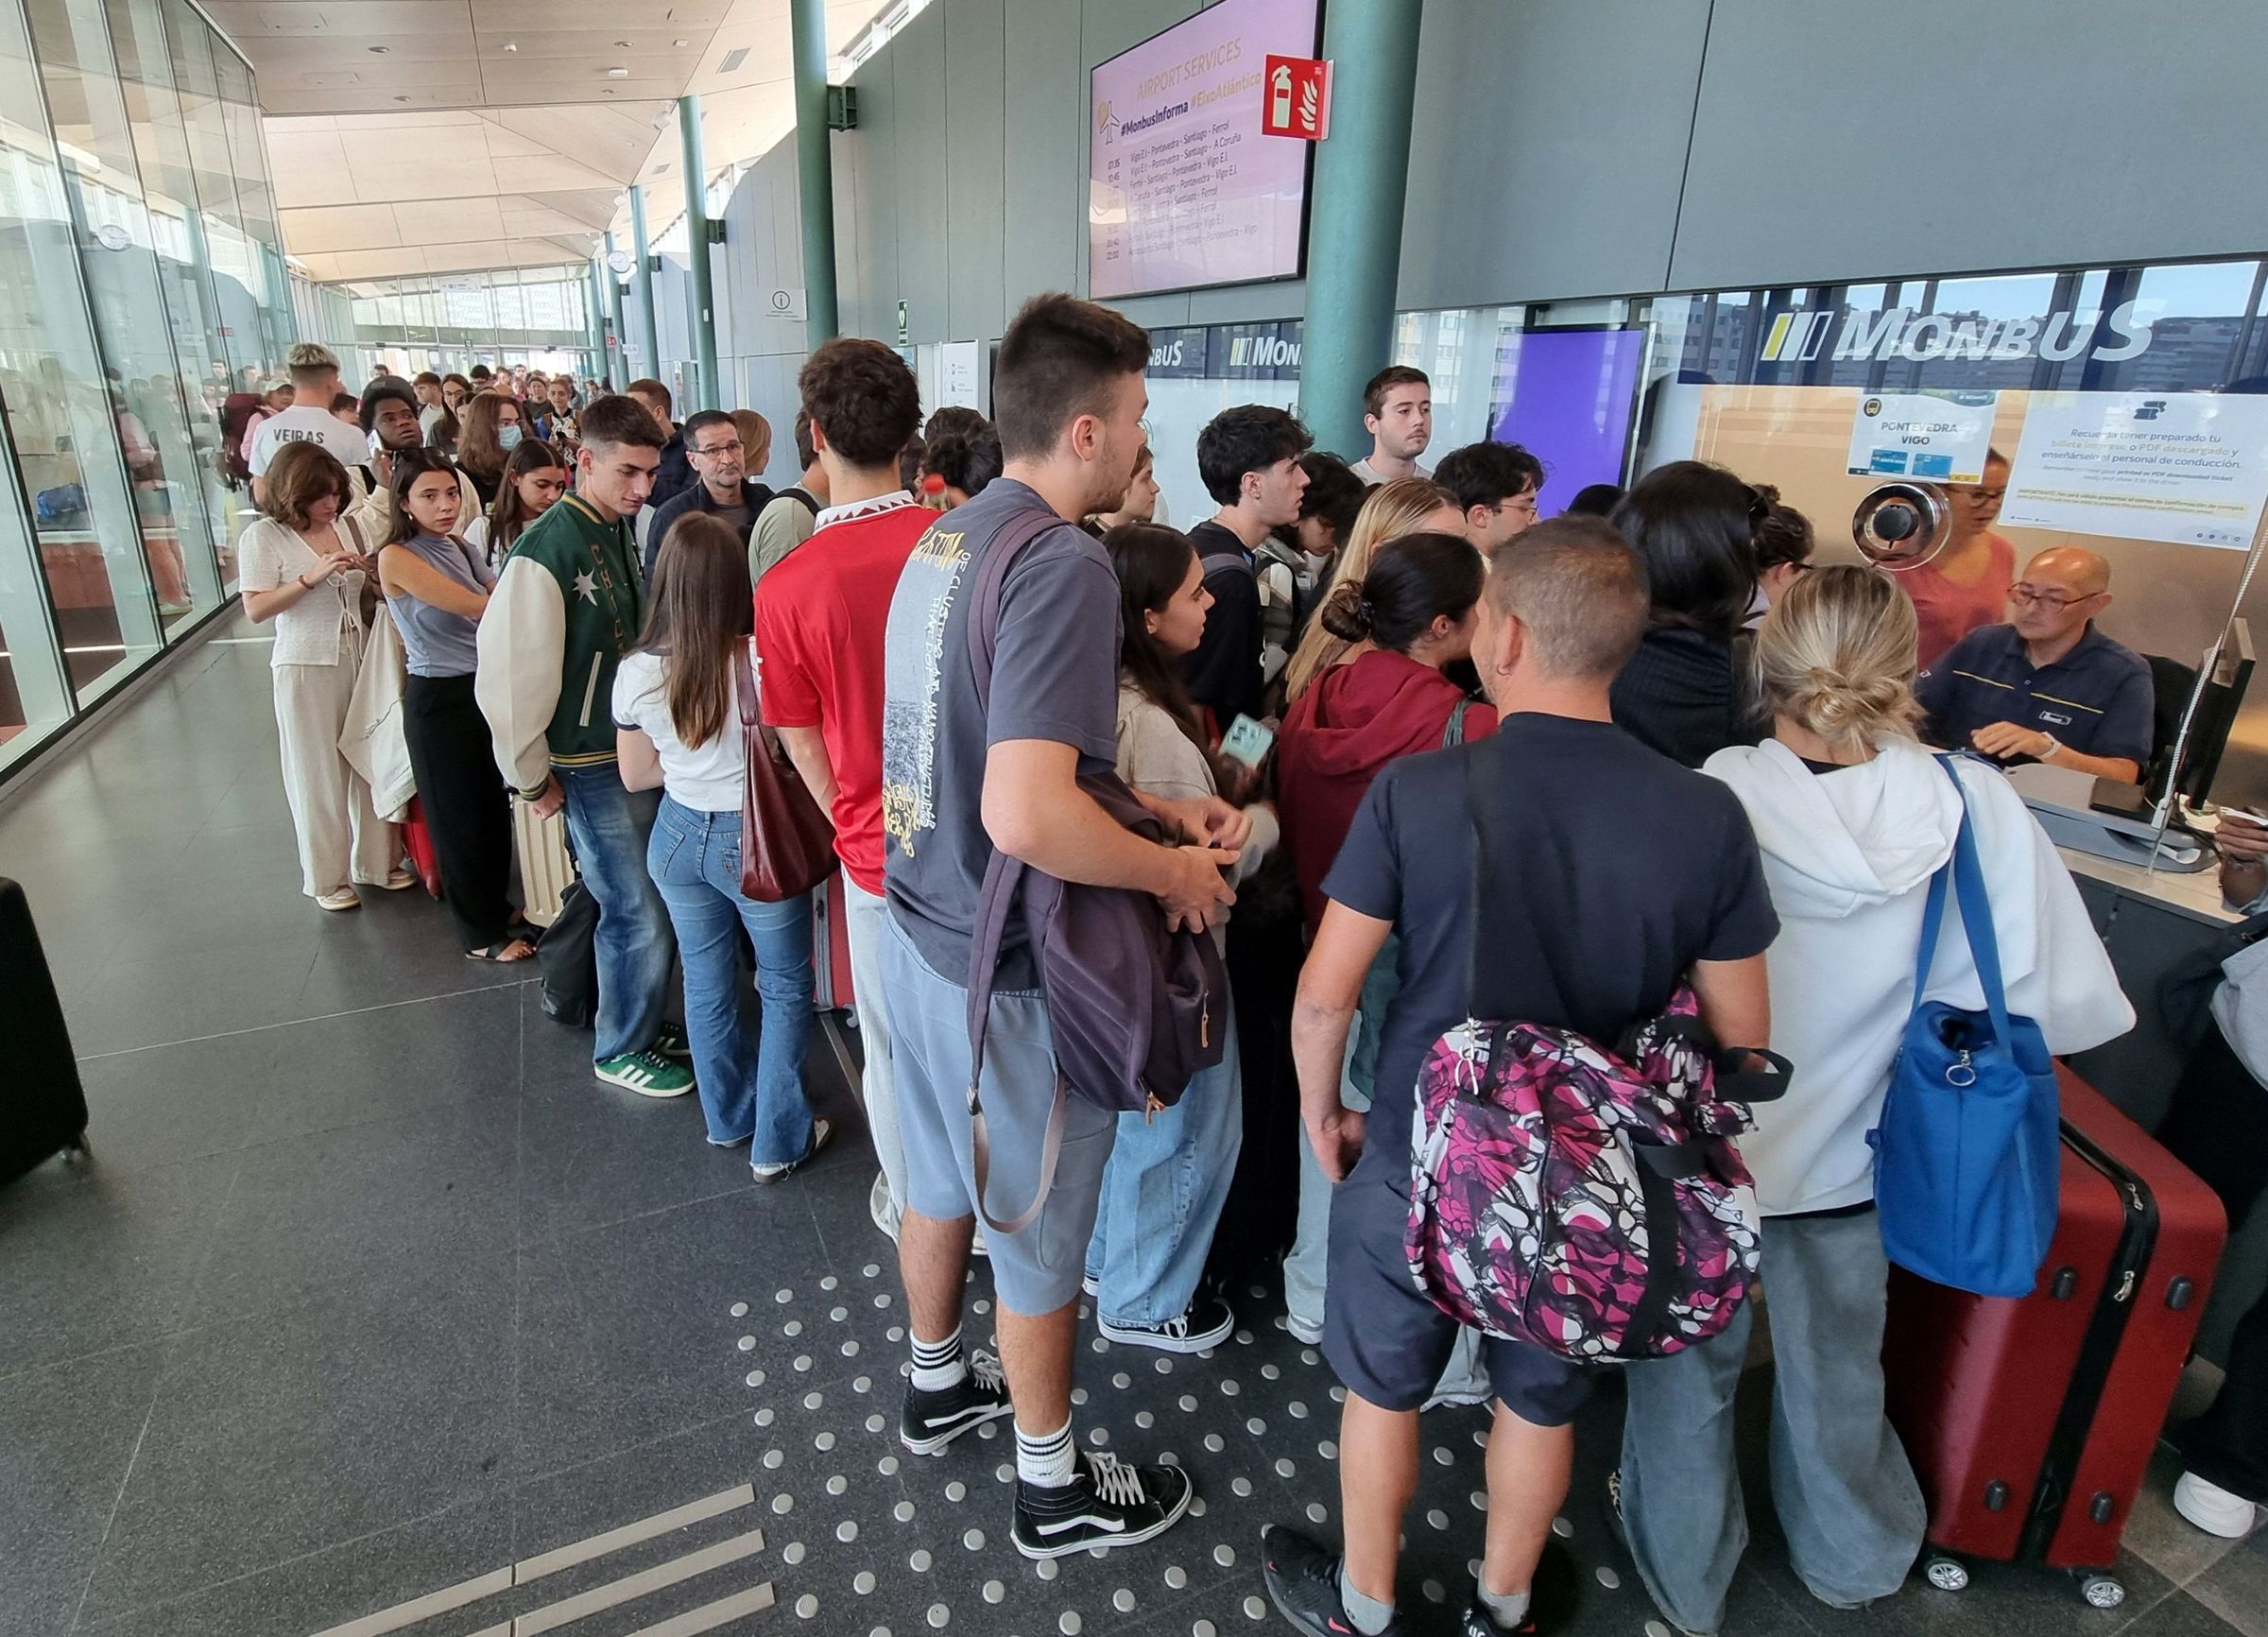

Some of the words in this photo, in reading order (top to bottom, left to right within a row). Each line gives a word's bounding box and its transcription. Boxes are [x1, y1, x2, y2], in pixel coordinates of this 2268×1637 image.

[1136, 64, 1182, 101] AIRPORT
[1183, 37, 1242, 81] SERVICES
[1120, 100, 1189, 137] #MonbusInforma
[1211, 119, 1229, 135] Ferrol
[1219, 131, 1242, 147] Coruña
[1201, 184, 1218, 198] Ferrol
[1830, 298, 2169, 363] MONBUS
[1252, 336, 1302, 367] MON
[273, 428, 325, 444] VEIRAS
[1881, 422, 1958, 434] PONTEVEDRA
[1901, 436, 1931, 445] VIGO
[2150, 433, 2207, 443] preparado
[2209, 435, 2222, 443] tu
[2041, 451, 2099, 460] enseñárselo
[2112, 455, 2157, 464] personal
[2158, 456, 2173, 465] de
[2139, 442, 2162, 452] PDF
[2162, 444, 2229, 456] descargado
[2230, 448, 2239, 458] y
[958, 552, 971, 573] OF
